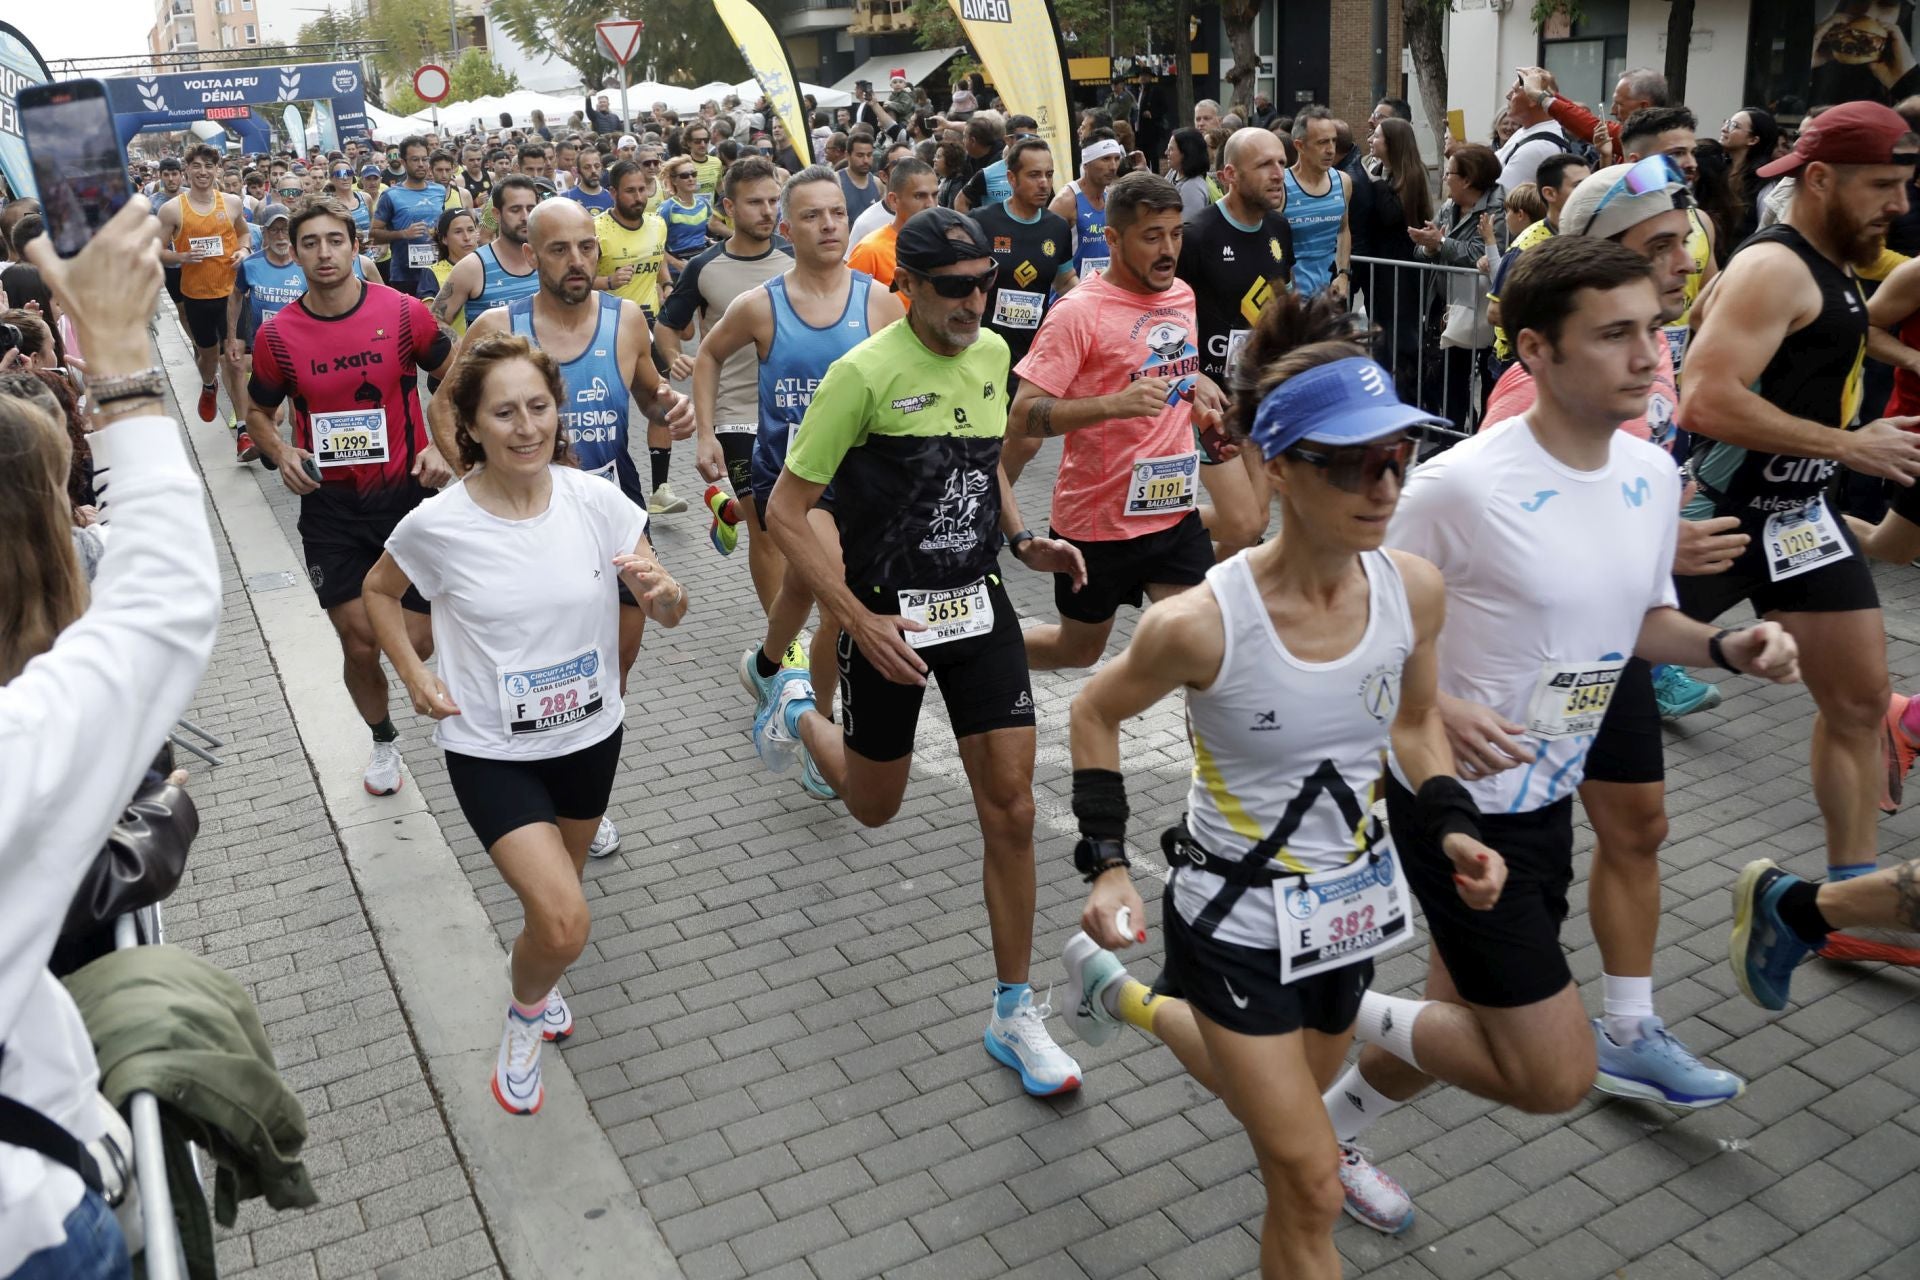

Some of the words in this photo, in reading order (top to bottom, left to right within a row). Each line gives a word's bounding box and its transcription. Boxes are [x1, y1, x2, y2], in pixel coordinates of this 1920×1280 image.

[184, 78, 221, 90] VOLTA
[222, 78, 233, 88] A
[234, 77, 259, 88] PEU
[202, 90, 245, 103] DÉNIA
[1009, 308, 1031, 319] 1220
[311, 359, 328, 376] la
[333, 350, 383, 371] xara
[322, 439, 329, 450] S
[334, 435, 368, 450] 1299
[334, 450, 369, 459] BALEARIA
[1137, 486, 1146, 498] S
[1151, 482, 1180, 498] 1191
[1147, 498, 1180, 508] BALEARIA
[1772, 543, 1783, 557] B
[1783, 531, 1815, 554] 1219
[931, 591, 952, 602] SOM
[953, 585, 979, 597] ESPORT
[928, 598, 968, 622] 3655
[530, 668, 558, 680] CIRCUIT
[566, 662, 578, 673] PEU
[535, 675, 561, 685] MARINA
[561, 670, 577, 678] ALTA
[533, 684, 553, 693] CLARA
[555, 675, 581, 688] EUGENIA
[516, 704, 526, 719] F
[540, 689, 579, 717] 282
[1567, 685, 1610, 711] 3643
[535, 707, 587, 729] BALEARIA
[1301, 929, 1312, 948] E
[1329, 904, 1375, 942] 382
[1319, 928, 1384, 960] BALEARIA
